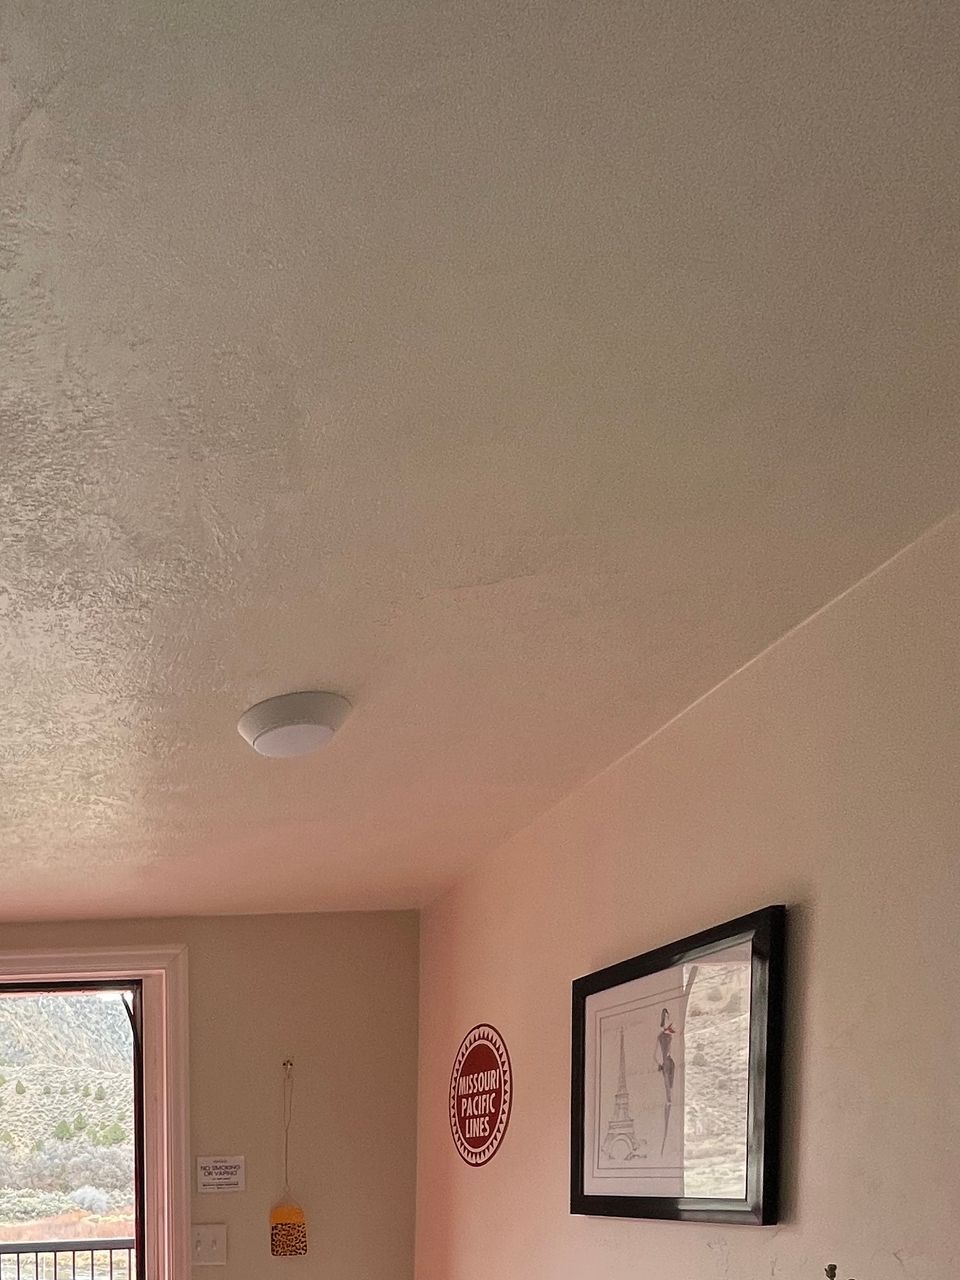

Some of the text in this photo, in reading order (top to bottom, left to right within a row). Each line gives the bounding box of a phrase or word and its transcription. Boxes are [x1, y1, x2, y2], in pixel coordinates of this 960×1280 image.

[458, 1068, 500, 1096] MISSOURI
[461, 1093, 496, 1117] PACIFIC
[465, 1116, 490, 1138] LINES
